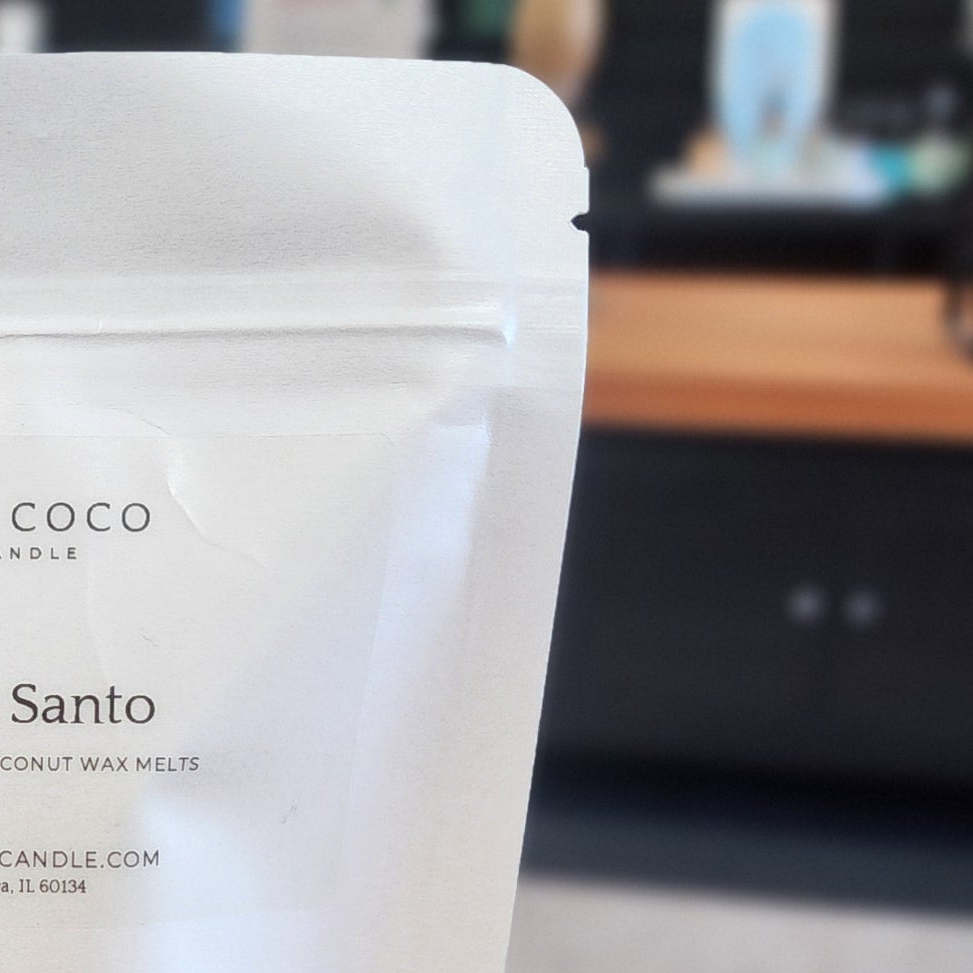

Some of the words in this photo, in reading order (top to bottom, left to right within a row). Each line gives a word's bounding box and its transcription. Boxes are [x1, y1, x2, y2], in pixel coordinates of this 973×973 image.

[11, 502, 152, 533] COCO
[11, 682, 156, 725] Santo
[80, 756, 129, 772] WAX
[136, 756, 200, 773] MELTS
[18, 879, 35, 894] IL
[38, 878, 87, 895] 60134
